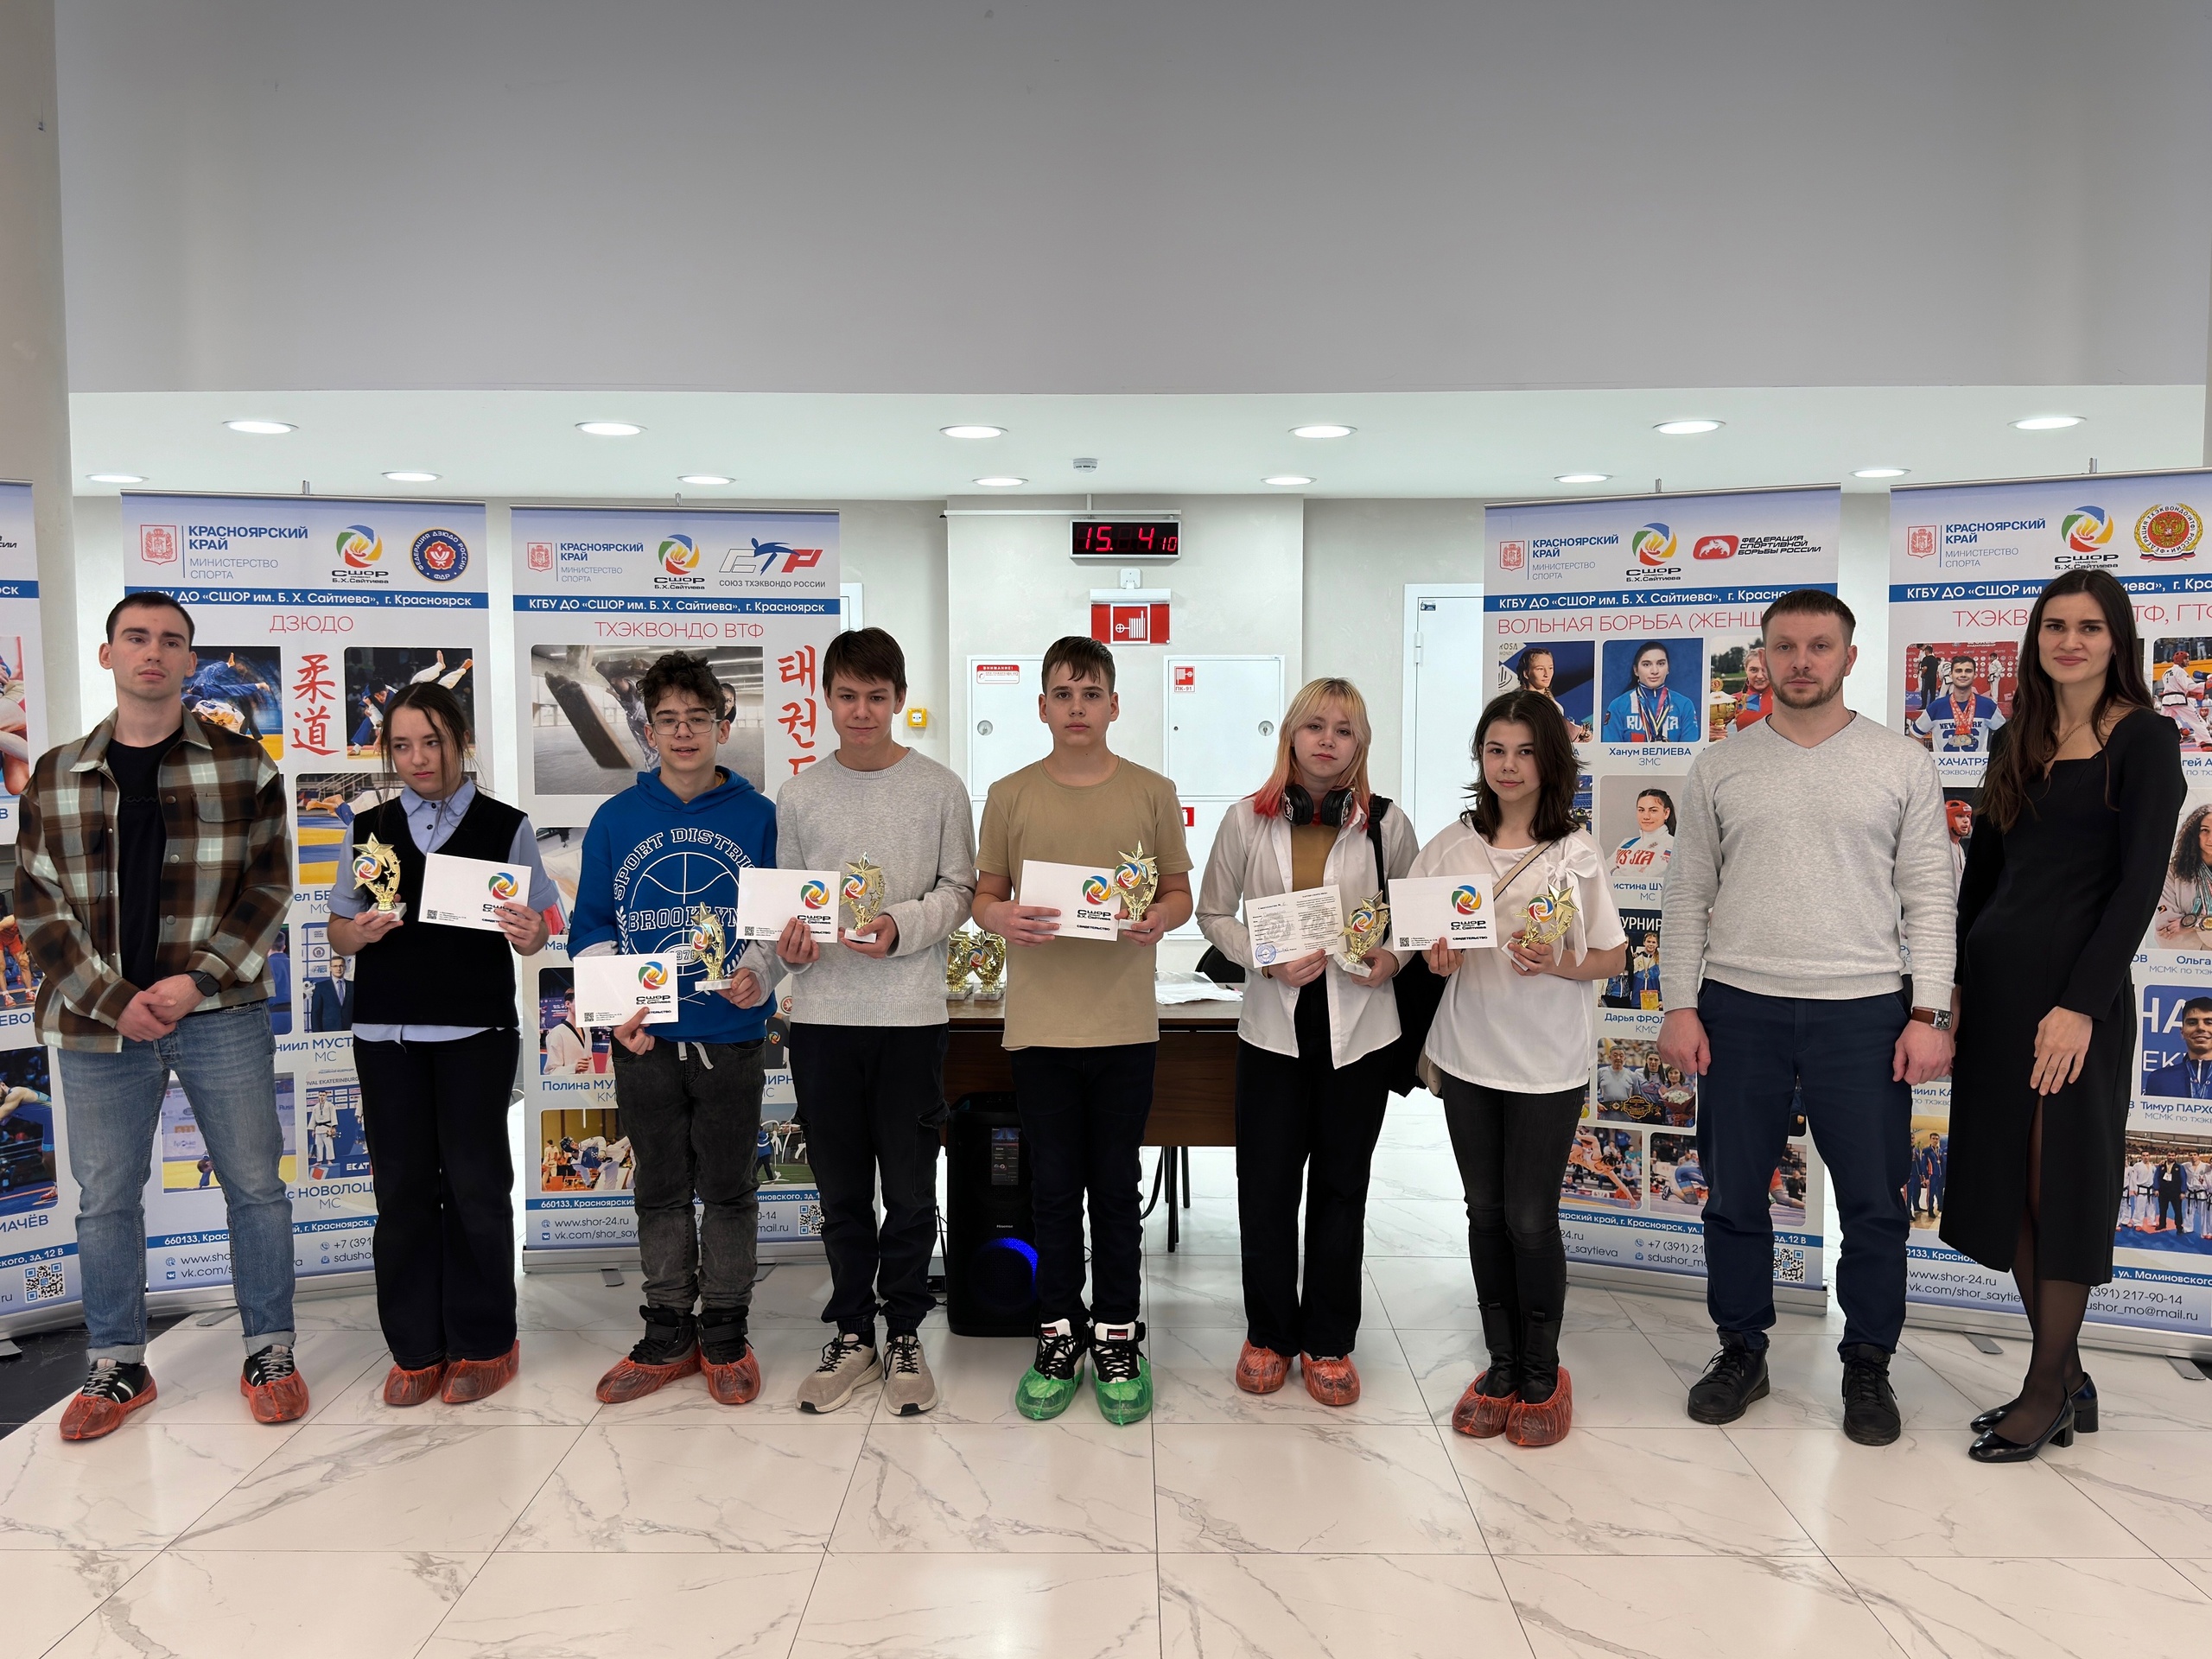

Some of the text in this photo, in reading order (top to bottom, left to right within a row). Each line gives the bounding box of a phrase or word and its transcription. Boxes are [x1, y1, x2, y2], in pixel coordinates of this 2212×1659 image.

[1946, 518, 2046, 533] КРАСНОЯРСКИЙ
[188, 525, 308, 539] КРАСНОЯРСКИЙ
[1946, 532, 1978, 544] КРАЙ
[2140, 520, 2165, 553] ФЕДЕРАЦИЯ
[2171, 533, 2195, 553] РОССИИ
[188, 537, 228, 550] КРАЙ
[1533, 534, 1619, 548] КРАСНОЯРСКИЙ
[1739, 540, 1808, 549] СПОРТИВНОЙ
[1742, 535, 1804, 543] ФЕДЕРАЦИЯ
[414, 531, 467, 571] ФЕДЕРАЦИЯ ДЗЮДО РОССИИ
[560, 543, 644, 552] КРАСНОЯРСКИЙ
[1533, 547, 1560, 558] КРАЙ
[1945, 548, 2018, 558] МИНИСТЕРСТВО
[560, 552, 588, 561] КРАЙ
[190, 558, 278, 569] МИНИСТЕРСТВО
[1532, 562, 1596, 571] МИНИСТЕРСТВО
[1945, 559, 1980, 568] СПОРТА
[190, 570, 234, 580] СПОРТА
[1532, 572, 1563, 581] СПОРТА
[0, 586, 19, 594] ск
[1907, 587, 1939, 599] КГБУ
[1942, 586, 1965, 599] ДО
[1968, 584, 2019, 596] «СШОР
[2173, 581, 2180, 590] г.
[177, 592, 200, 602] ДО
[202, 592, 251, 602] «СШОР
[253, 594, 275, 603] им.
[278, 593, 289, 602] Б.
[292, 594, 304, 603] Х.
[308, 593, 379, 605] Сайтиева»,
[395, 594, 472, 607] Красноярск
[1499, 592, 1734, 609] КГБУ ДО «СШОР им. Б. Х. Сайтиева», г.
[529, 599, 557, 608] КГБУ
[559, 599, 580, 610] ДО
[582, 600, 625, 610] «СШОР
[627, 601, 646, 610] им.
[650, 601, 659, 610] Б.
[663, 601, 673, 611] Х.
[676, 601, 741, 612] Сайтиева»,
[755, 602, 824, 613] Красноярск
[1498, 616, 1592, 634] ВОЛЬНАЯ
[1599, 613, 1682, 632] БОРЬБА
[1952, 608, 2028, 627] ТХЭКВ
[270, 615, 354, 633] ДЗЮДО
[594, 621, 764, 639] ТХЭКВОНДО ВТФ
[291, 653, 340, 756] 柔道
[1609, 747, 1692, 757] Ханум ВЕЛИЕВА
[1638, 757, 1661, 766] ЗМС
[613, 828, 756, 901] SPORT DISTRI
[1640, 893, 1656, 901] МС
[1620, 916, 1662, 931] УРНИР
[2176, 956, 2211, 965] Ольга
[2149, 965, 2177, 974] МСМК
[1604, 1013, 1634, 1023] Дарья
[1635, 1025, 1657, 1034] КМС
[313, 1037, 353, 1050] МУСТ
[315, 1051, 337, 1063] МС
[543, 1081, 590, 1090] Полина
[2140, 1101, 2174, 1113] Тимур
[2145, 1112, 2173, 1122] МСМК
[319, 1198, 341, 1210] МС
[541, 1200, 572, 1209] 660133,
[311, 1219, 372, 1231] Красноярск,
[555, 1217, 629, 1227] www.shor-24.ru
[1593, 1217, 1619, 1226] край,
[1627, 1218, 1686, 1232] Красноярск,
[164, 1233, 230, 1245] 660133, Крас
[334, 1237, 373, 1249] +7 (391
[58, 1248, 64, 1256] В
[1648, 1240, 1660, 1249] +7
[1663, 1241, 1689, 1253] (391)
[334, 1251, 373, 1262] sdusho
[1909, 1270, 1997, 1286] www.shor-24.ru
[2118, 1270, 2132, 1279] ул.
[2123, 1289, 2183, 1306] 217-90-14
